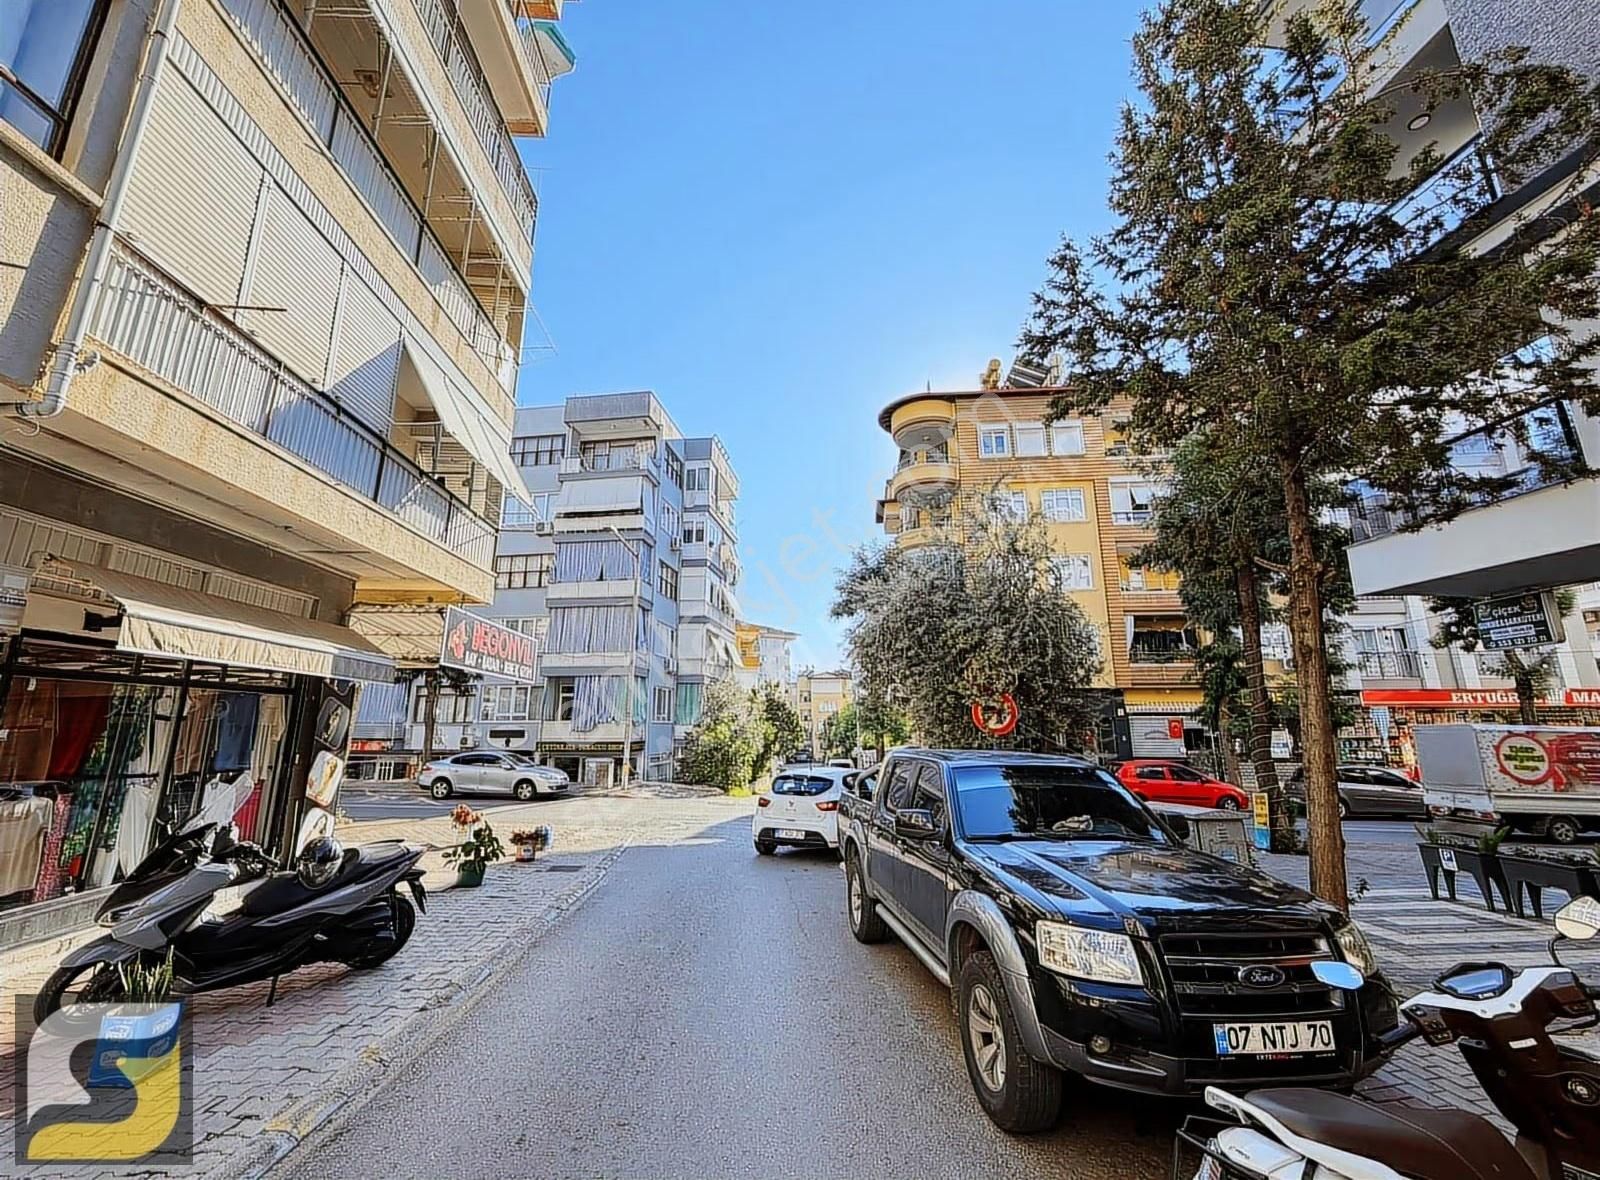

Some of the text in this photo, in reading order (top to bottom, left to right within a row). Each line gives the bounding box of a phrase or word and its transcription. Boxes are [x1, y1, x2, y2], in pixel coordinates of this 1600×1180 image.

[1492, 605, 1521, 618] ÇİÇEK
[1451, 690, 1544, 704] ERTUĞRL
[1250, 969, 1274, 983] Ford
[1227, 1026, 1251, 1050] 07
[1261, 1025, 1299, 1050] NTJ
[1307, 1023, 1332, 1048] 70
